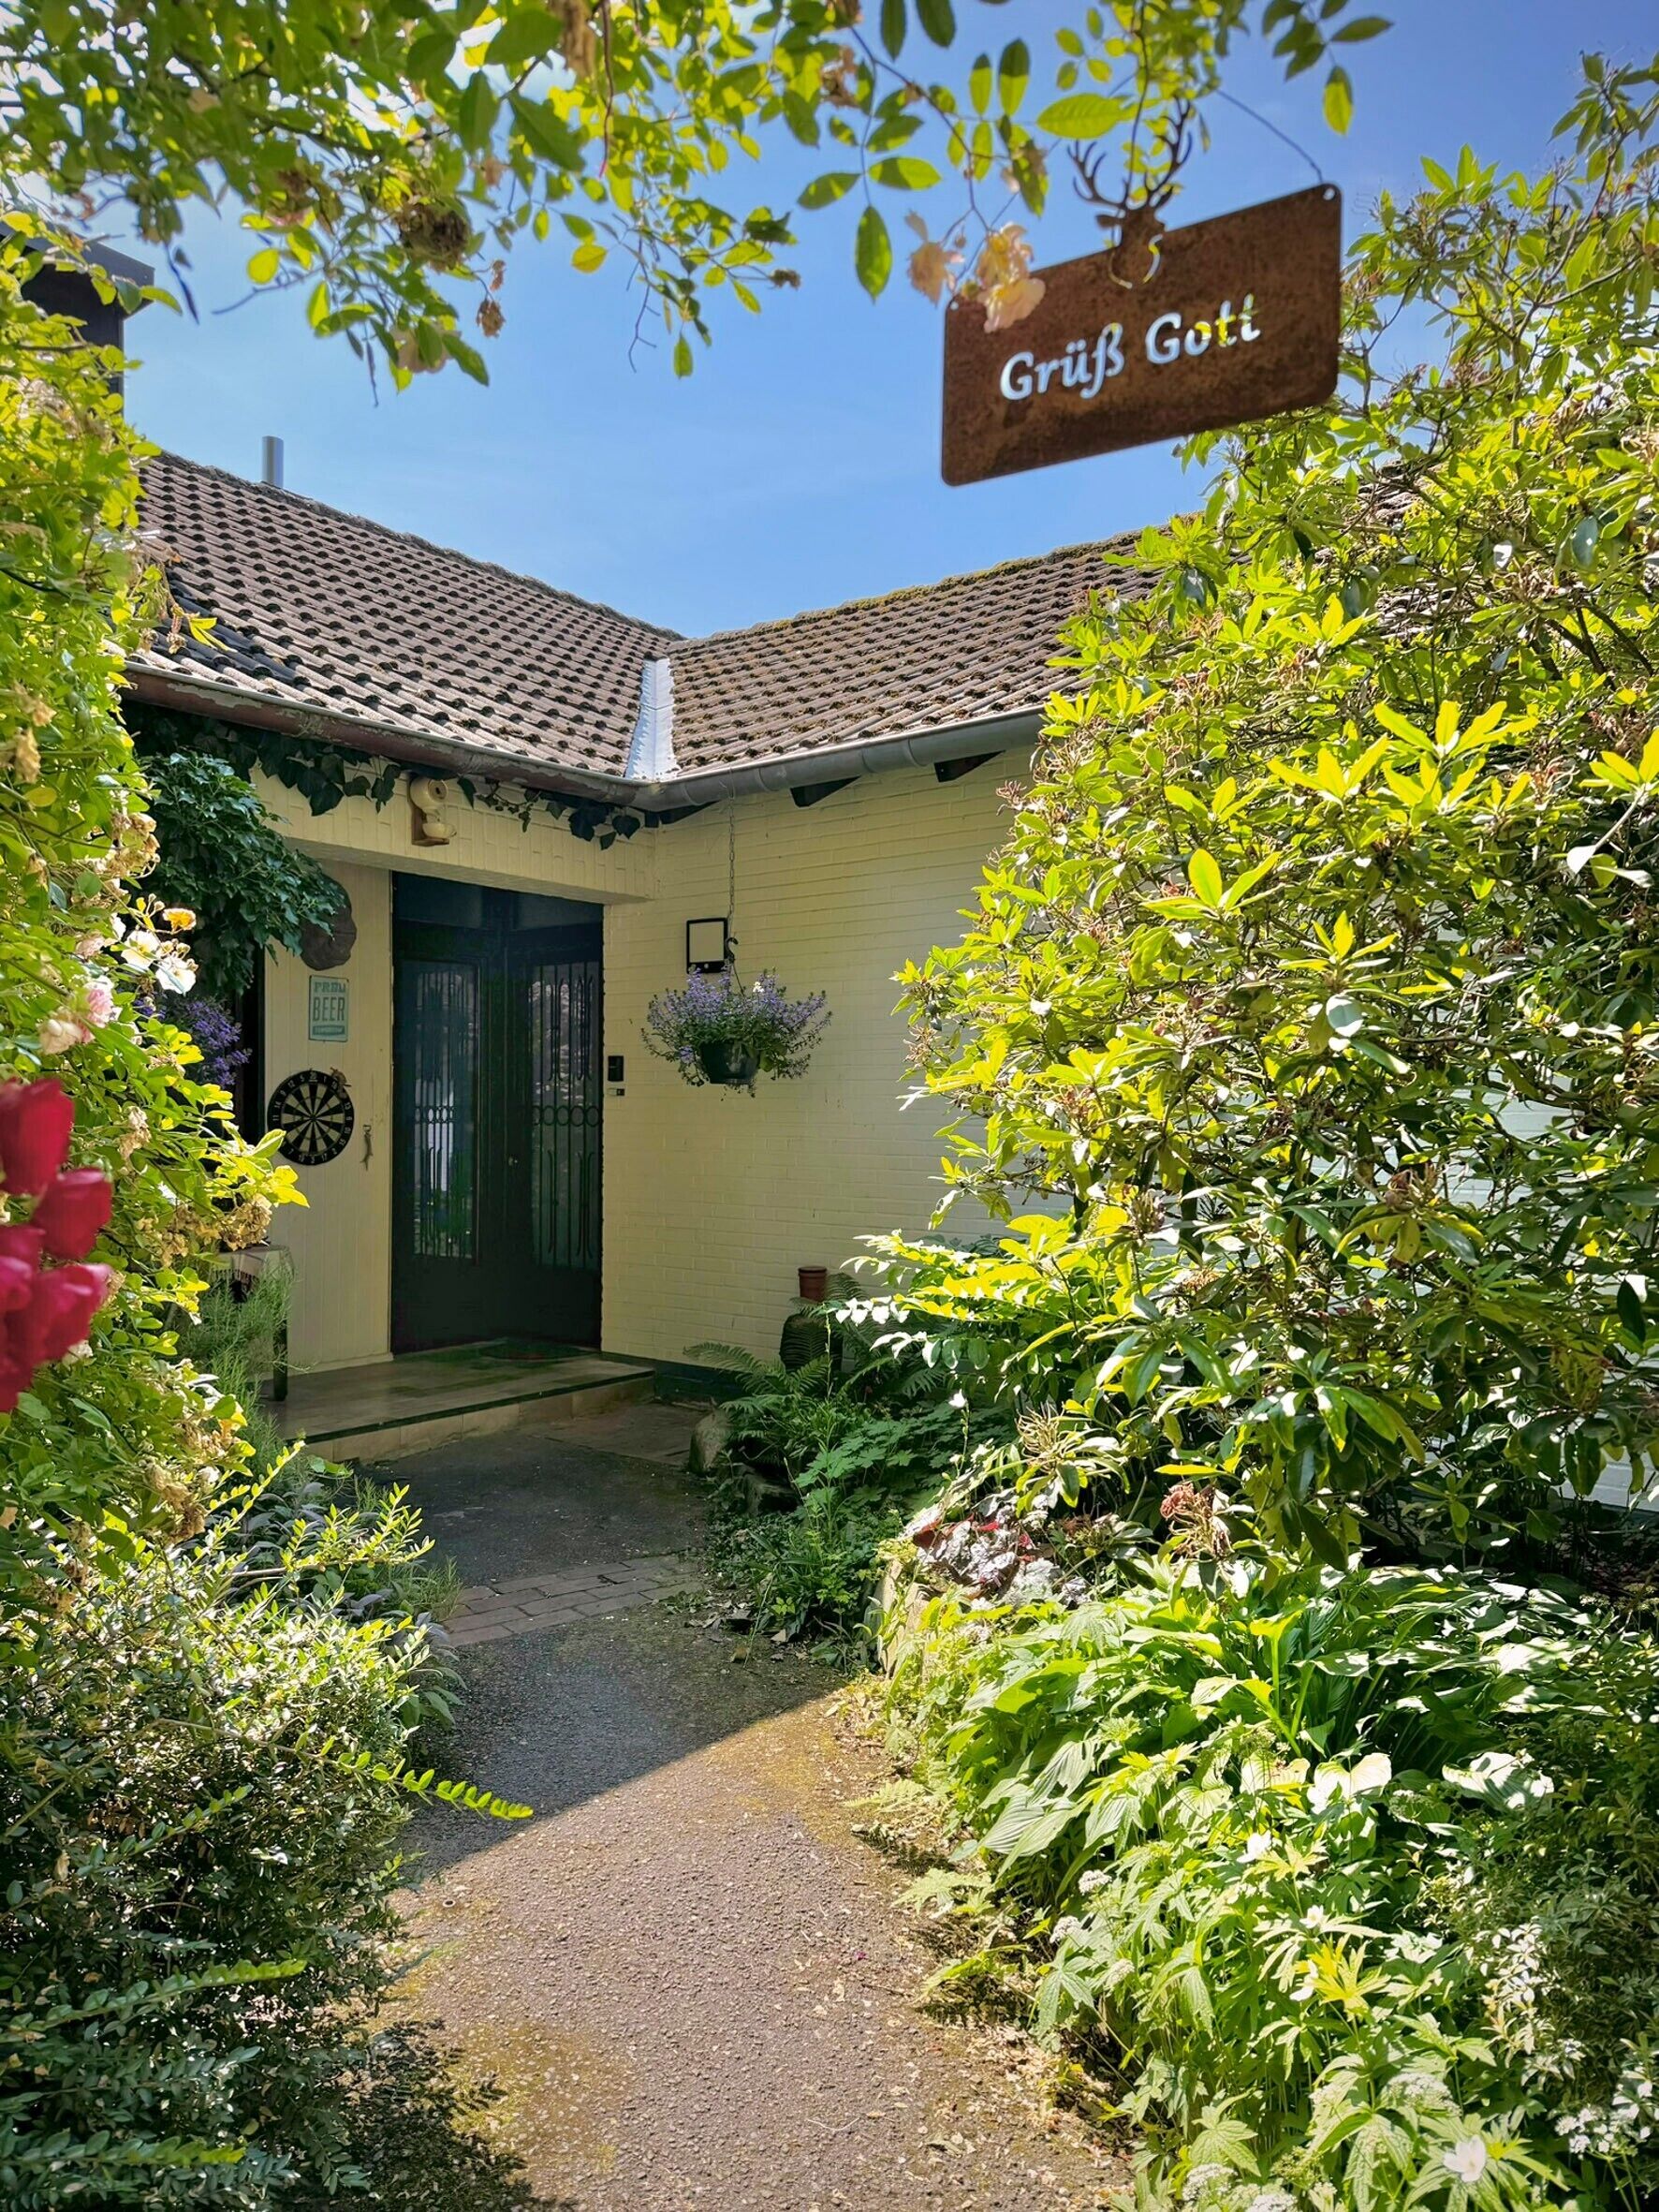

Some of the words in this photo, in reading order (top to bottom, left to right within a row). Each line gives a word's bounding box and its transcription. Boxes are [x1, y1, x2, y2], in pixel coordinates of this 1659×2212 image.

[1000, 322, 1124, 400] Grüß
[1145, 293, 1261, 364] Gott
[313, 996, 345, 1022] BEER
